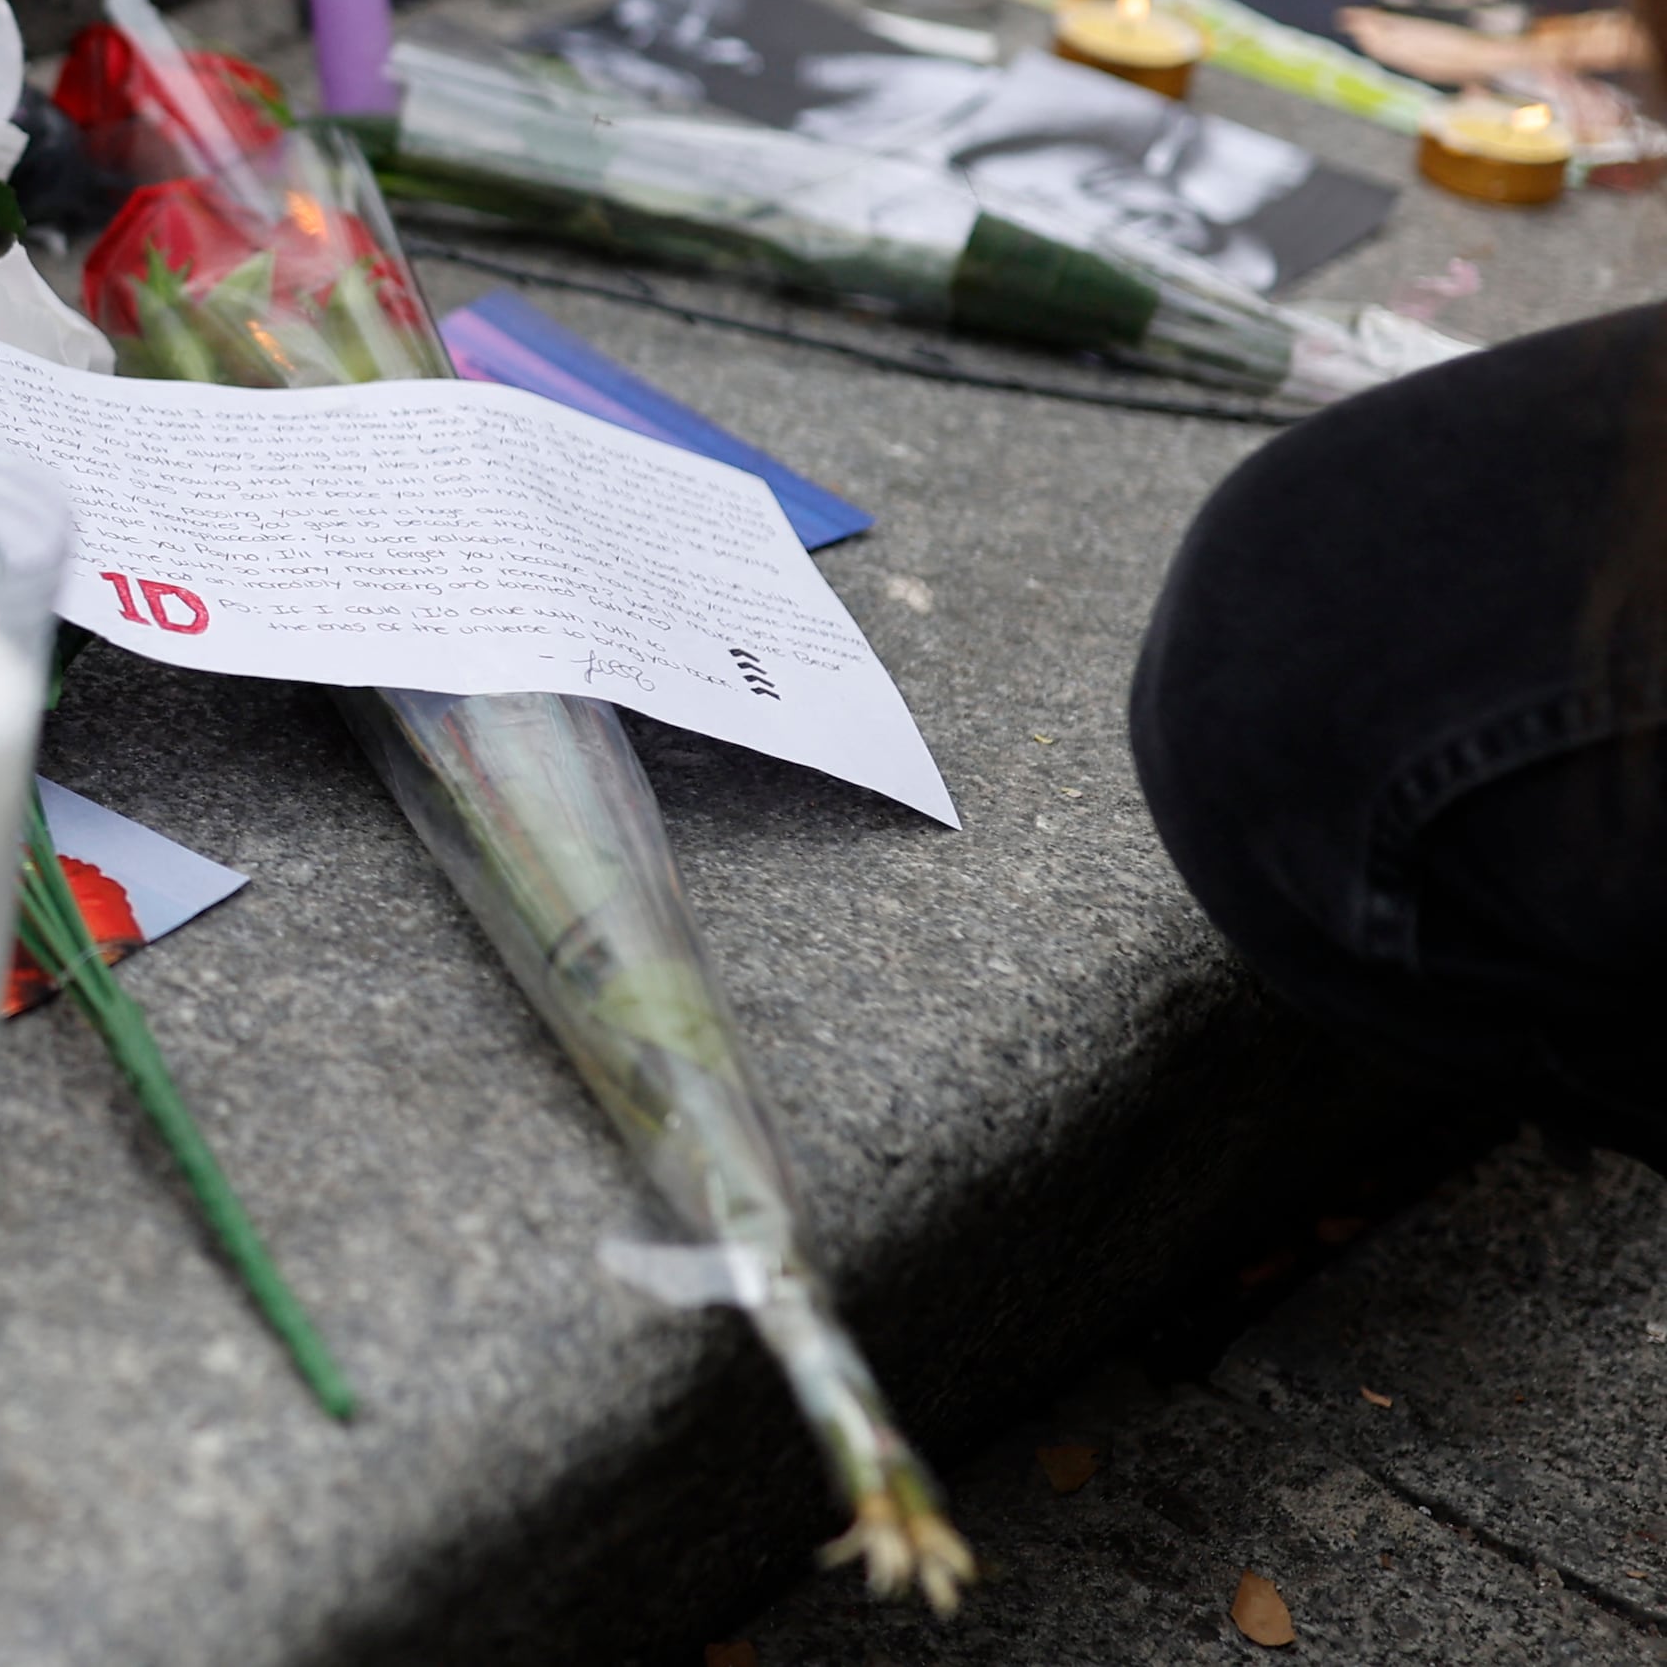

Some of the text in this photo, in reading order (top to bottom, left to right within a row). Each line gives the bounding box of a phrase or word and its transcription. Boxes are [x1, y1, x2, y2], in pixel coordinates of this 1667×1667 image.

[28, 416, 85, 438] thank
[186, 448, 256, 461] always
[60, 480, 114, 498] with
[122, 492, 168, 510] your
[180, 506, 261, 522] passing
[271, 507, 340, 519] you've
[347, 506, 388, 517] left
[414, 505, 465, 519] huge
[73, 464, 119, 480] Lord
[129, 477, 177, 495] gives
[186, 489, 227, 500] your
[239, 490, 279, 501] soul
[286, 489, 319, 498] the
[324, 490, 381, 499] peace
[390, 490, 425, 500] you
[433, 486, 490, 498] might
[159, 472, 242, 491] knowing
[432, 472, 472, 484] God
[78, 508, 614, 571] unique, You were valuable, you were
[149, 509, 600, 553] memories you gave us because that's who
[71, 520, 634, 593] I love you Payno, I'll never forget you, because how
[116, 561, 577, 598] he had an incredibly amazing and talented
[80, 537, 842, 671] left me with so many moments to Bear
[98, 571, 210, 636] 1D
[218, 598, 667, 653] PS: If I I'd drive with to
[267, 621, 739, 692] the ends of the universe to bring you back.
